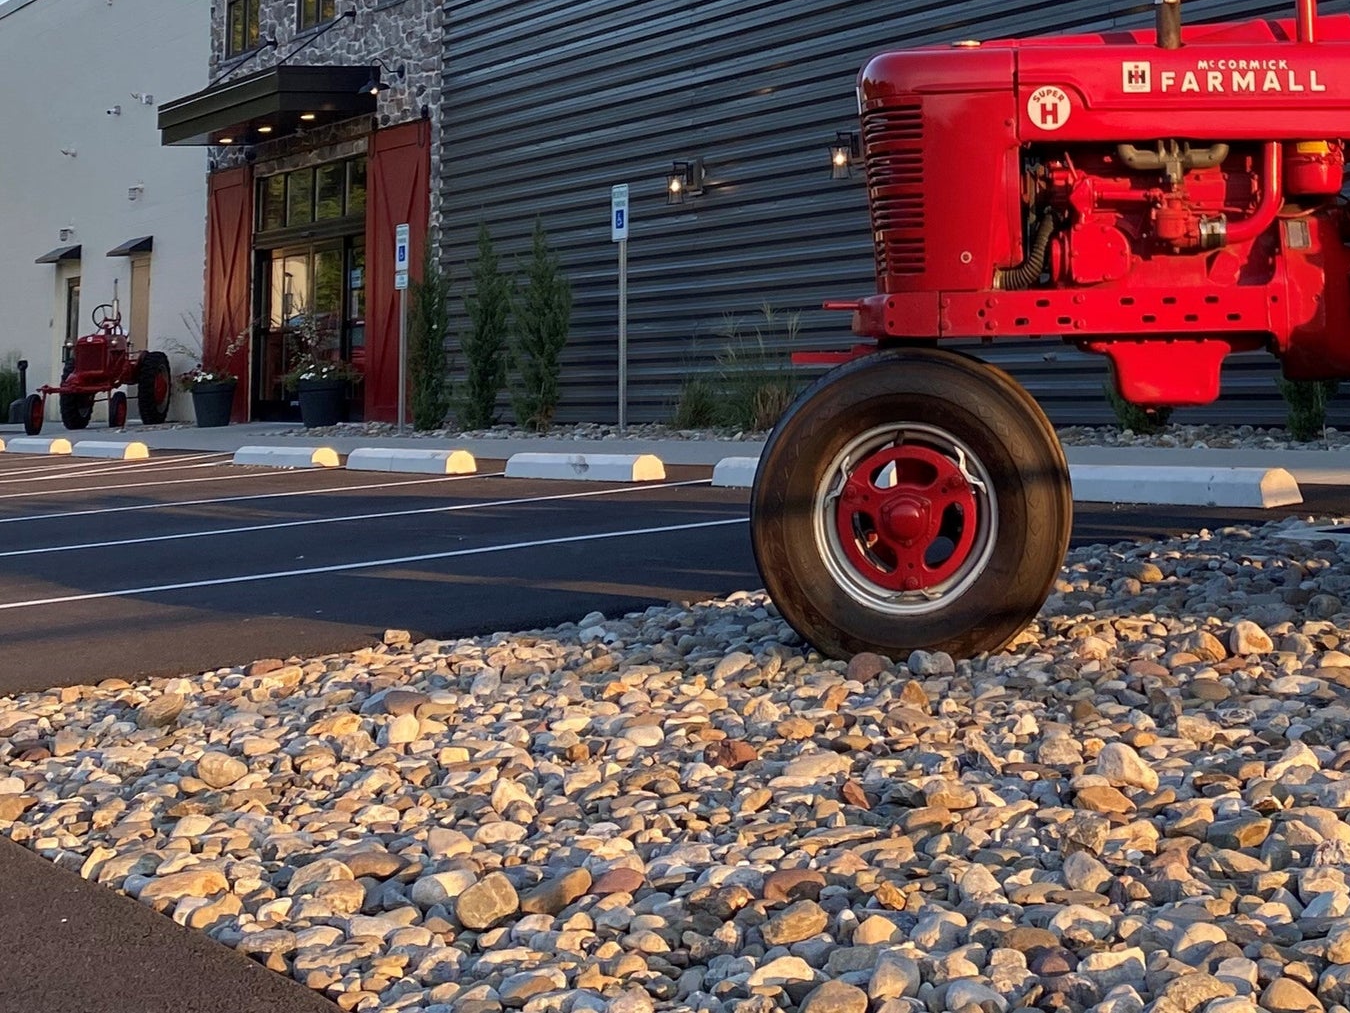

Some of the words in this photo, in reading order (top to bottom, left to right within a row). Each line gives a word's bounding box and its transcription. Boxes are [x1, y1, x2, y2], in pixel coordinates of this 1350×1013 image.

[1160, 70, 1327, 92] FARMALL
[1032, 89, 1065, 103] SUPER
[1040, 102, 1059, 125] H
